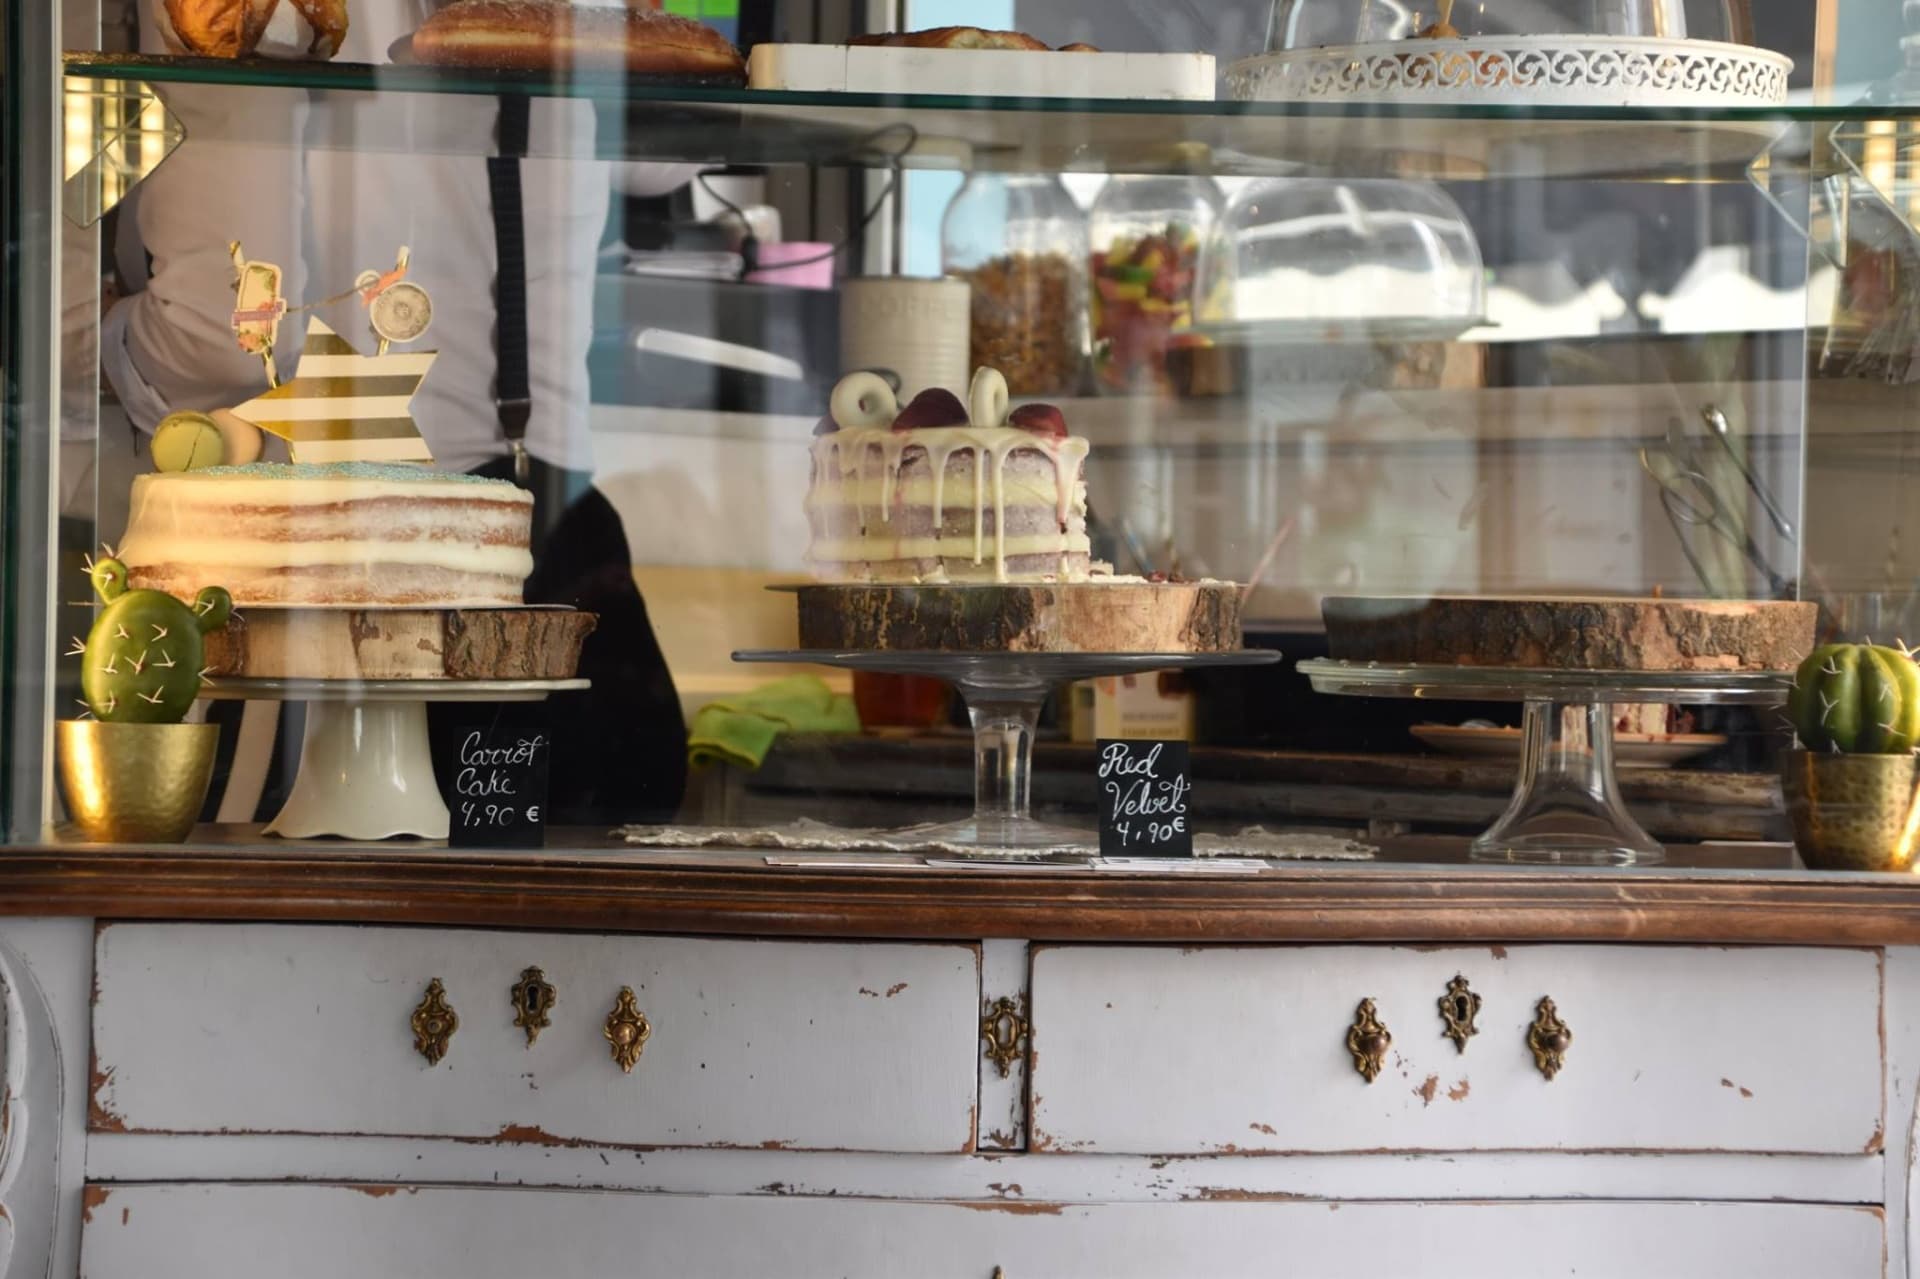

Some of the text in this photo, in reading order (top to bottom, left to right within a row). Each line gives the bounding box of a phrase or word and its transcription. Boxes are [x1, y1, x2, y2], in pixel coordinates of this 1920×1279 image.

[460, 731, 549, 766] Carrot
[1098, 742, 1163, 778] Red
[456, 767, 516, 796] Cake
[1105, 773, 1191, 821] Velvet
[461, 801, 540, 827] 4,90 €
